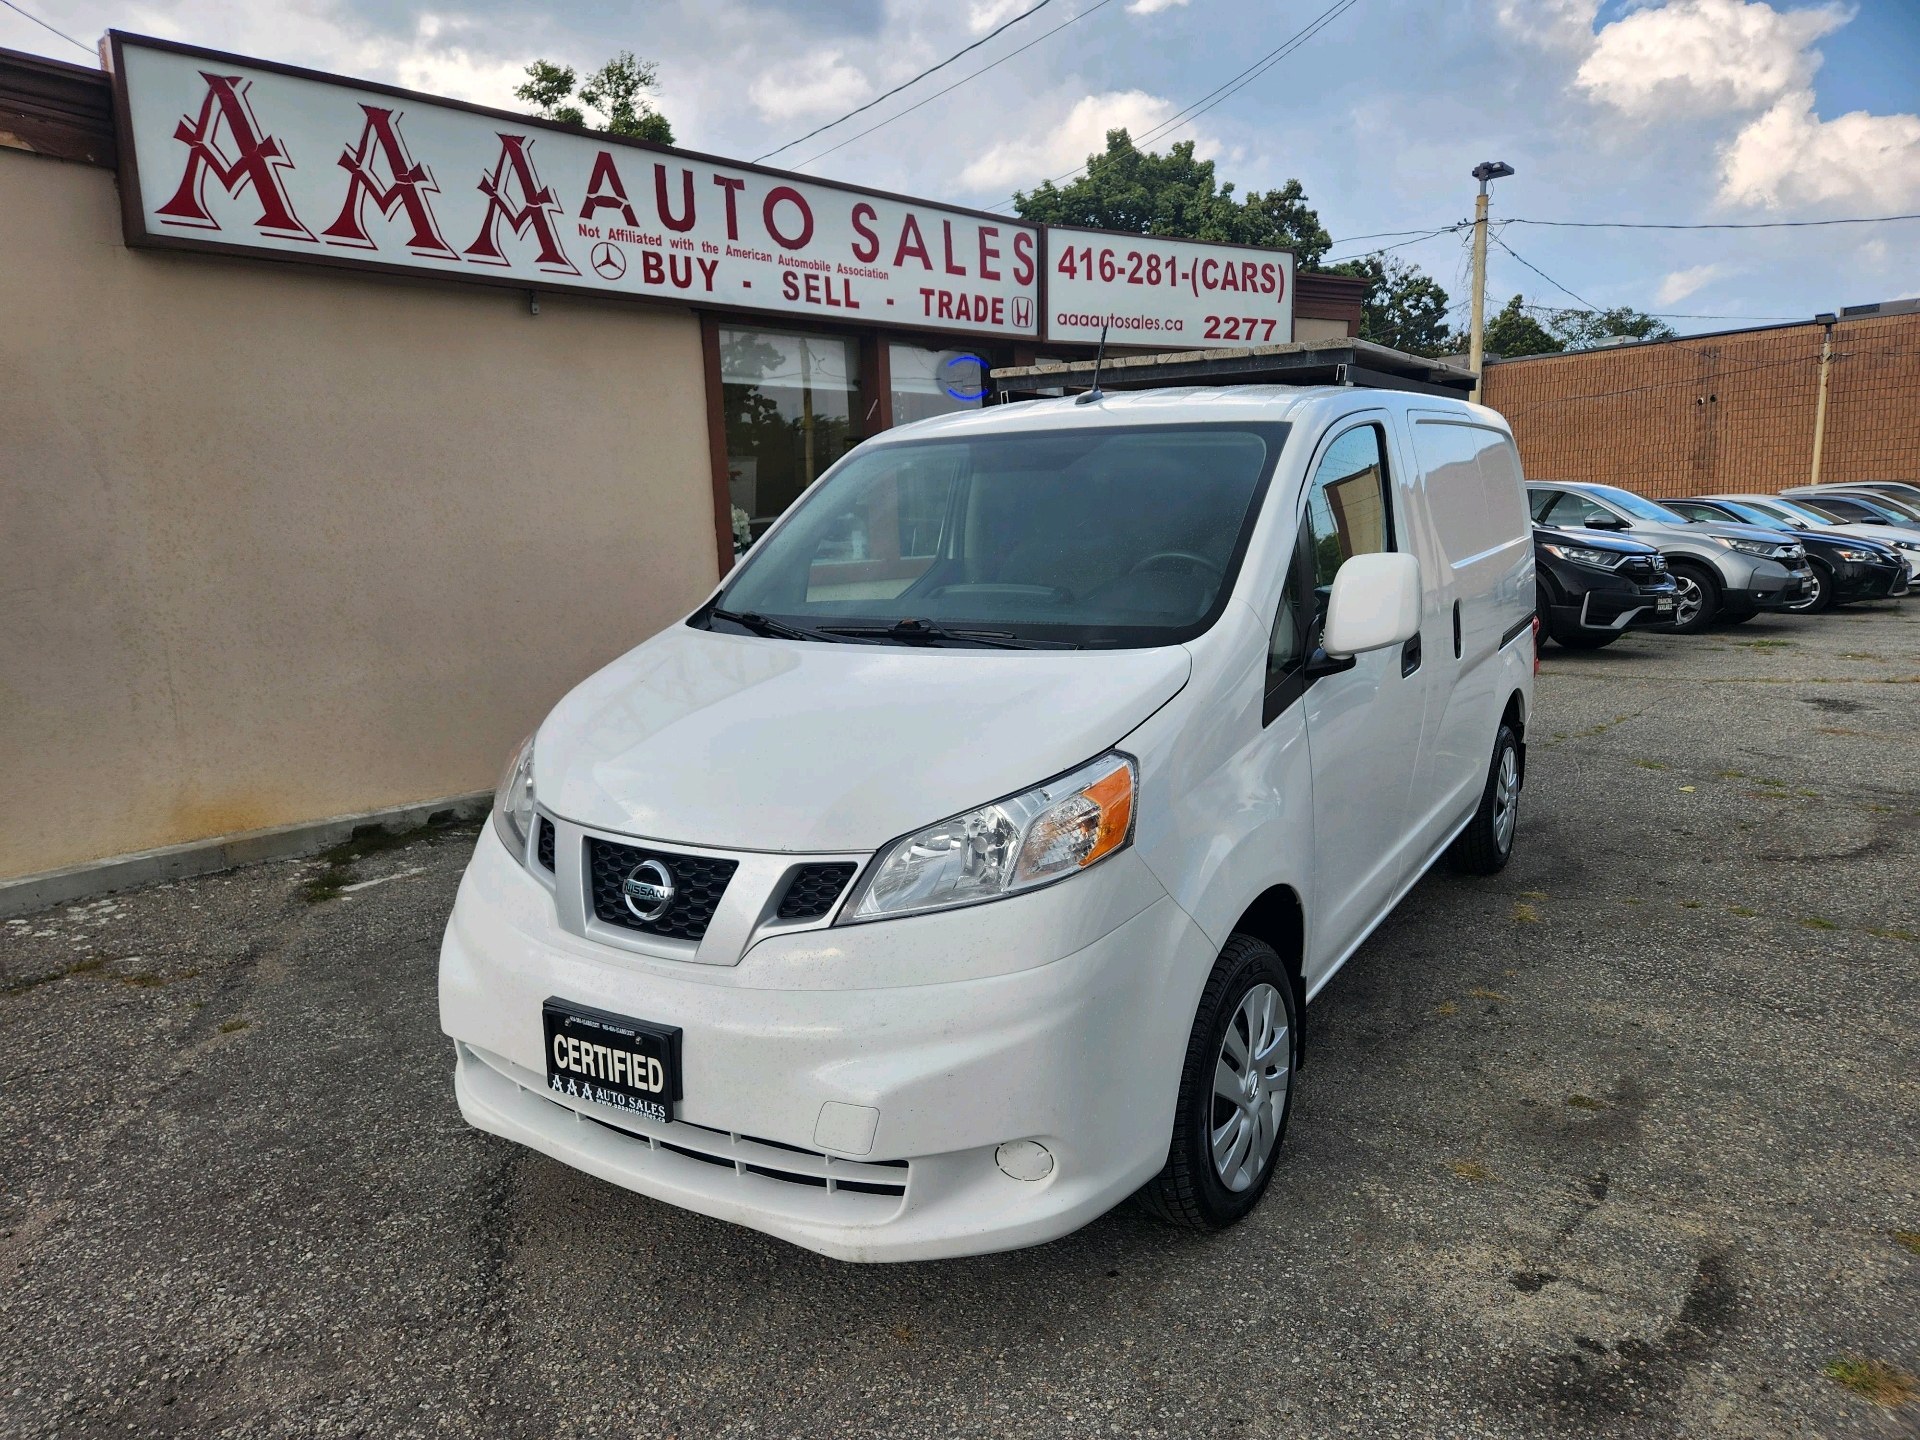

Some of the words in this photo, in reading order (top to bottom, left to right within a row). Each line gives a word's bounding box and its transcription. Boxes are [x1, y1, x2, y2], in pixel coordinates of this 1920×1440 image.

[578, 150, 814, 250] AUTO
[851, 202, 1035, 286] SALES
[578, 223, 600, 239] Not
[608, 228, 662, 247] Affiliated
[669, 237, 694, 252] with
[702, 241, 719, 255] the
[725, 244, 772, 263] American
[778, 253, 831, 272] Automobile
[837, 262, 889, 280] Association
[1057, 245, 1285, 303] 416-281-(CARS)
[642, 250, 719, 292] BUY
[782, 270, 860, 309] SELL
[919, 287, 1004, 325] TRADE
[1057, 312, 1183, 332] aaaautosales.ca
[1203, 315, 1277, 342] 2277
[624, 882, 665, 899] NISSAN
[553, 1033, 664, 1093] CERTIFIED
[595, 1087, 625, 1105] AUTO
[628, 1096, 666, 1117] SALES
